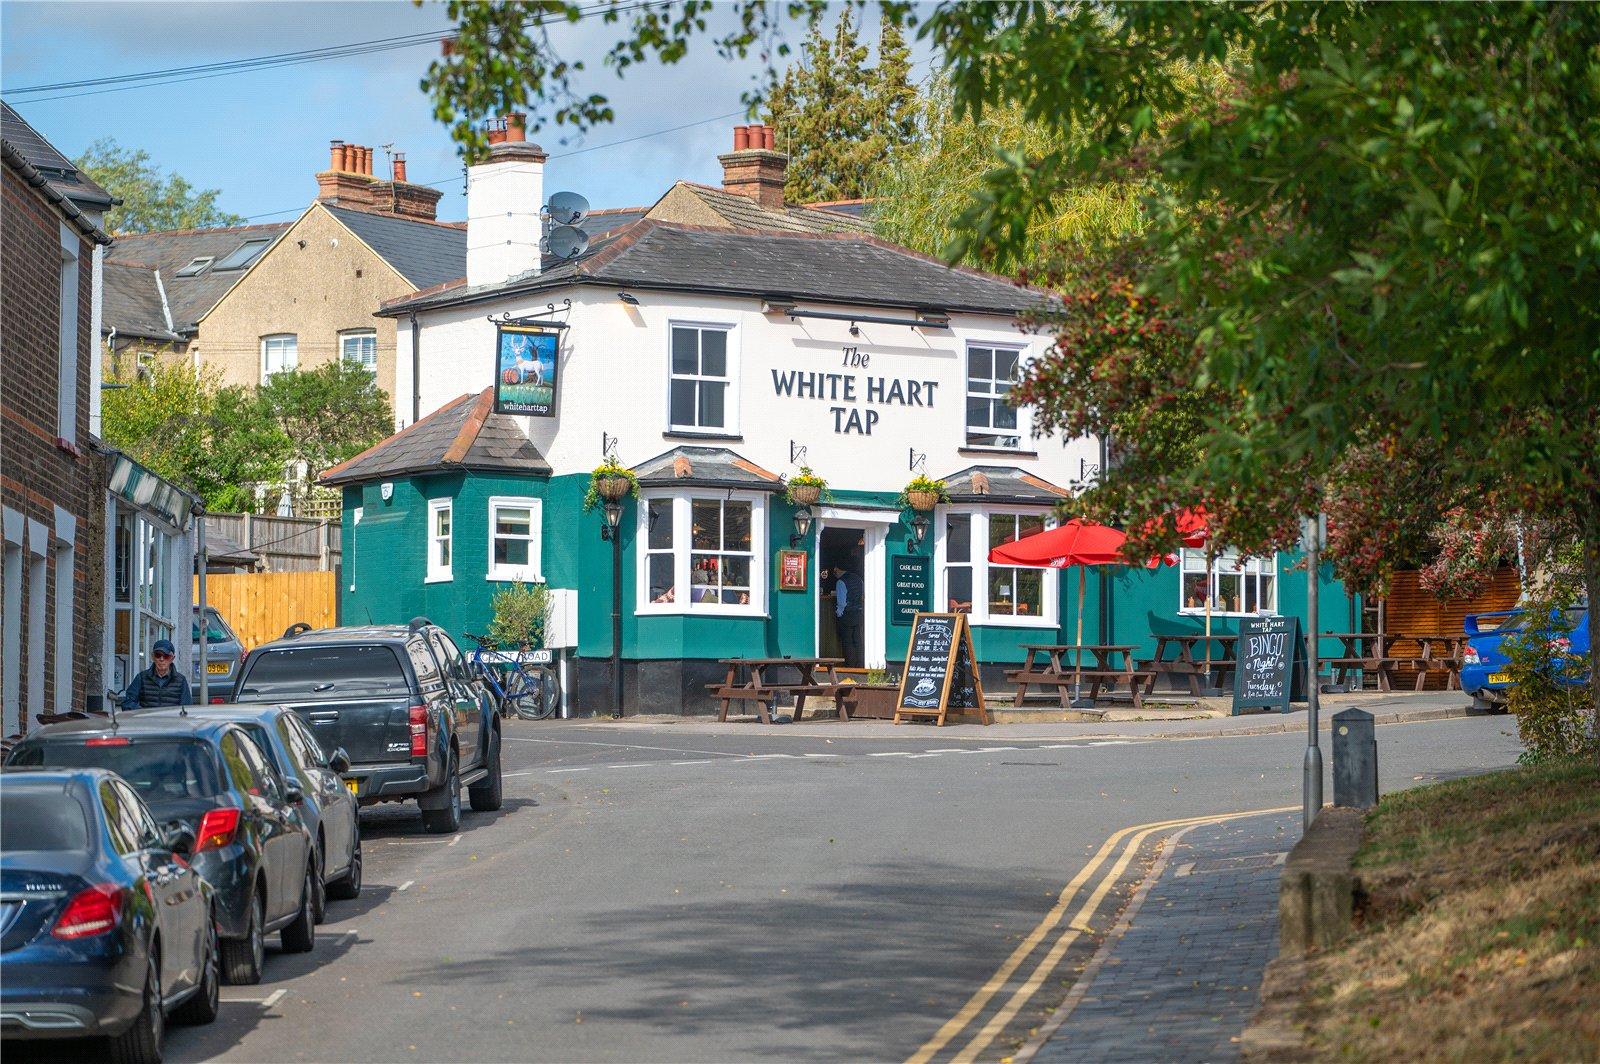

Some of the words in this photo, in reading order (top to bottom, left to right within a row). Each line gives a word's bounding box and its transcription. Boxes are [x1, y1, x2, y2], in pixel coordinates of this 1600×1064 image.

[842, 346, 870, 368] The
[771, 369, 857, 401] WHITE
[867, 377, 938, 407] HART
[503, 402, 548, 413] whiteharttap
[830, 407, 879, 435] TAP
[1249, 633, 1284, 658] BINGO
[521, 652, 548, 661] ROAD
[1253, 657, 1278, 672] Night!
[1246, 680, 1275, 690] Tuesday
